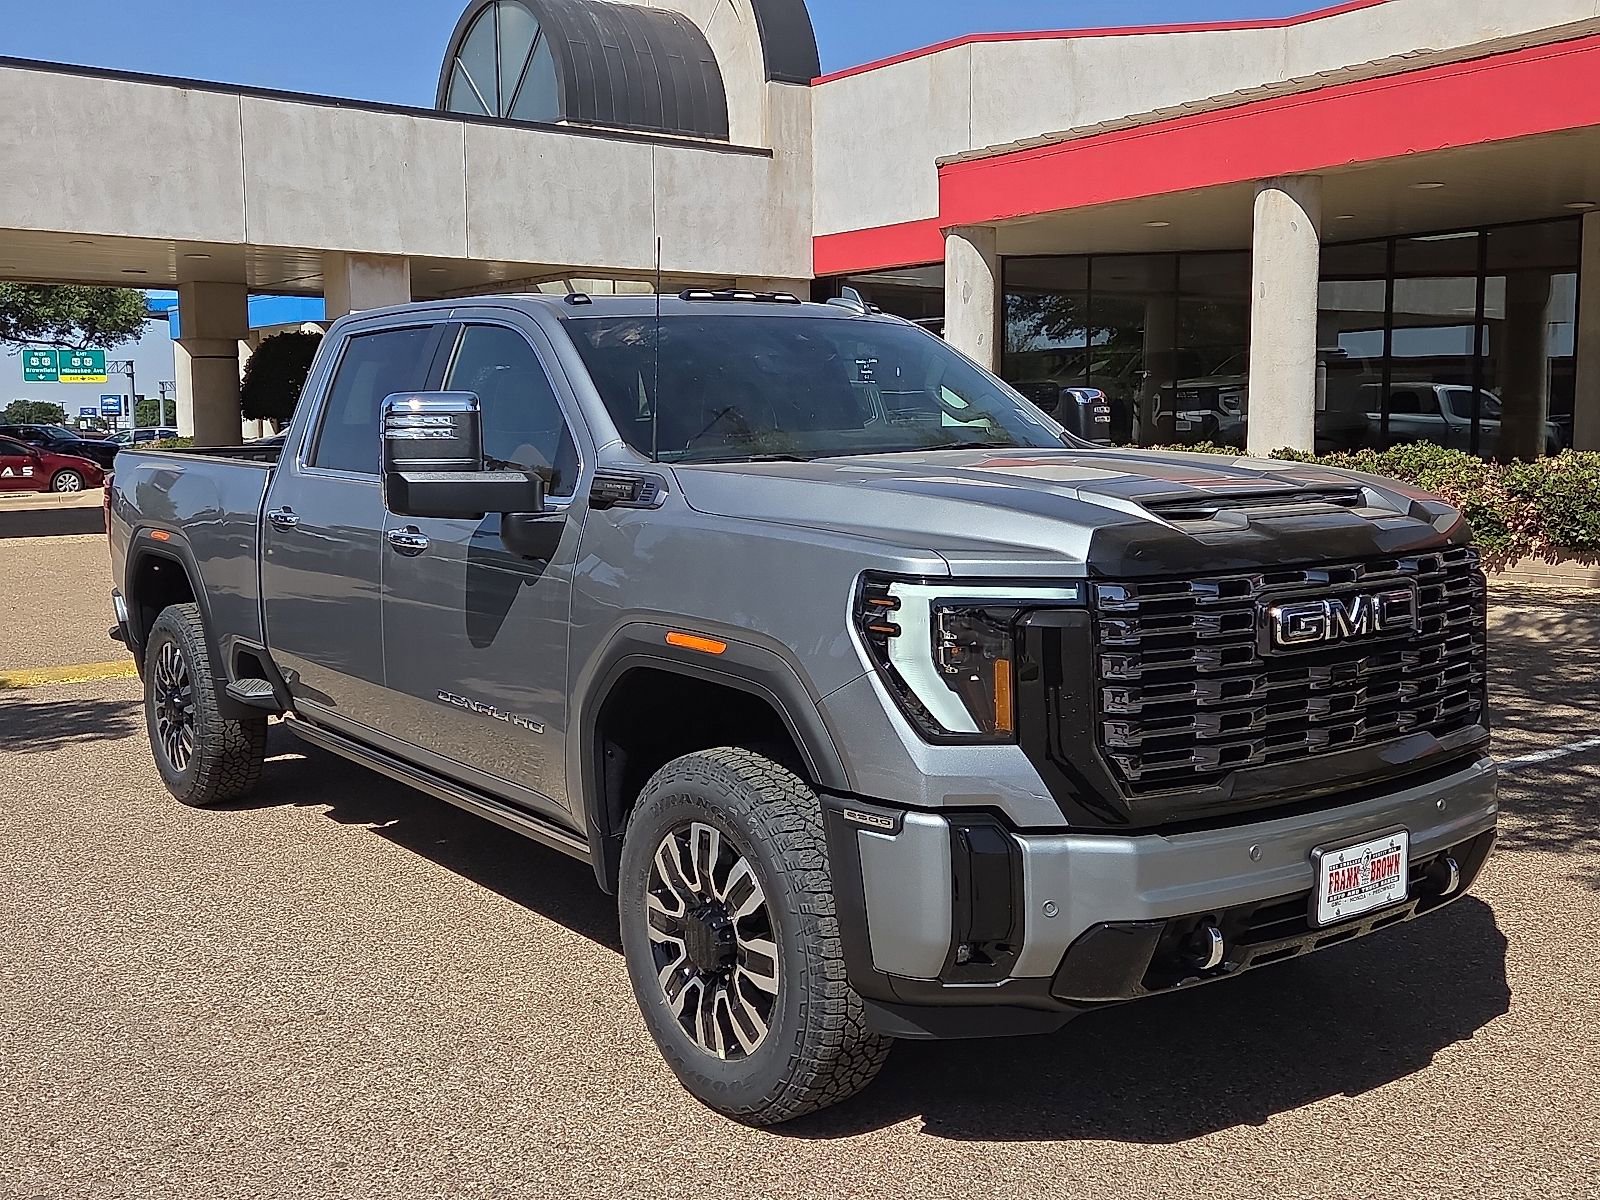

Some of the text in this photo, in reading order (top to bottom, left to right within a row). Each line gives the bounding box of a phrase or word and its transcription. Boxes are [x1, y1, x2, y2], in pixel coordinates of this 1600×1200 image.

[1274, 591, 1413, 645] GMC
[437, 689, 545, 734] DENALI HD
[1328, 852, 1401, 895] FRANK BROWN
[1329, 893, 1346, 902] AUTO
[1347, 889, 1360, 897] AND
[1362, 882, 1380, 892] TRUCK
[1380, 876, 1399, 886] RANCH
[1331, 899, 1342, 907] GMC
